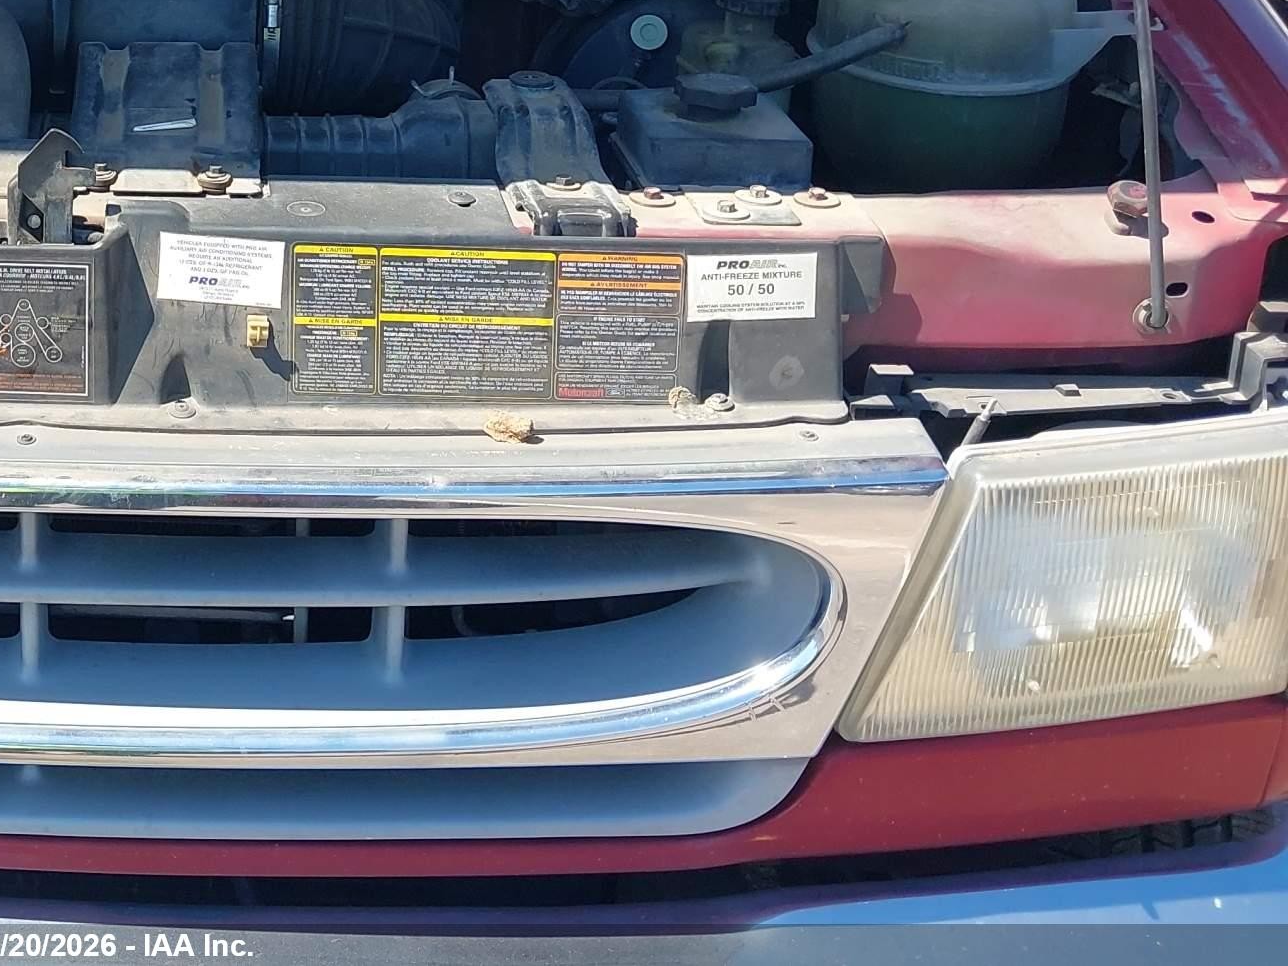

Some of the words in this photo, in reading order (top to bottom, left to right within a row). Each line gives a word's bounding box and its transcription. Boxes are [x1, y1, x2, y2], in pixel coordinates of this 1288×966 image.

[701, 272, 760, 280] ANTI-FREEZE
[762, 271, 802, 279] MIXTURE
[728, 284, 745, 296] 50
[748, 283, 754, 295] /
[758, 283, 775, 295] 50
[559, 388, 604, 397] Motorcraft
